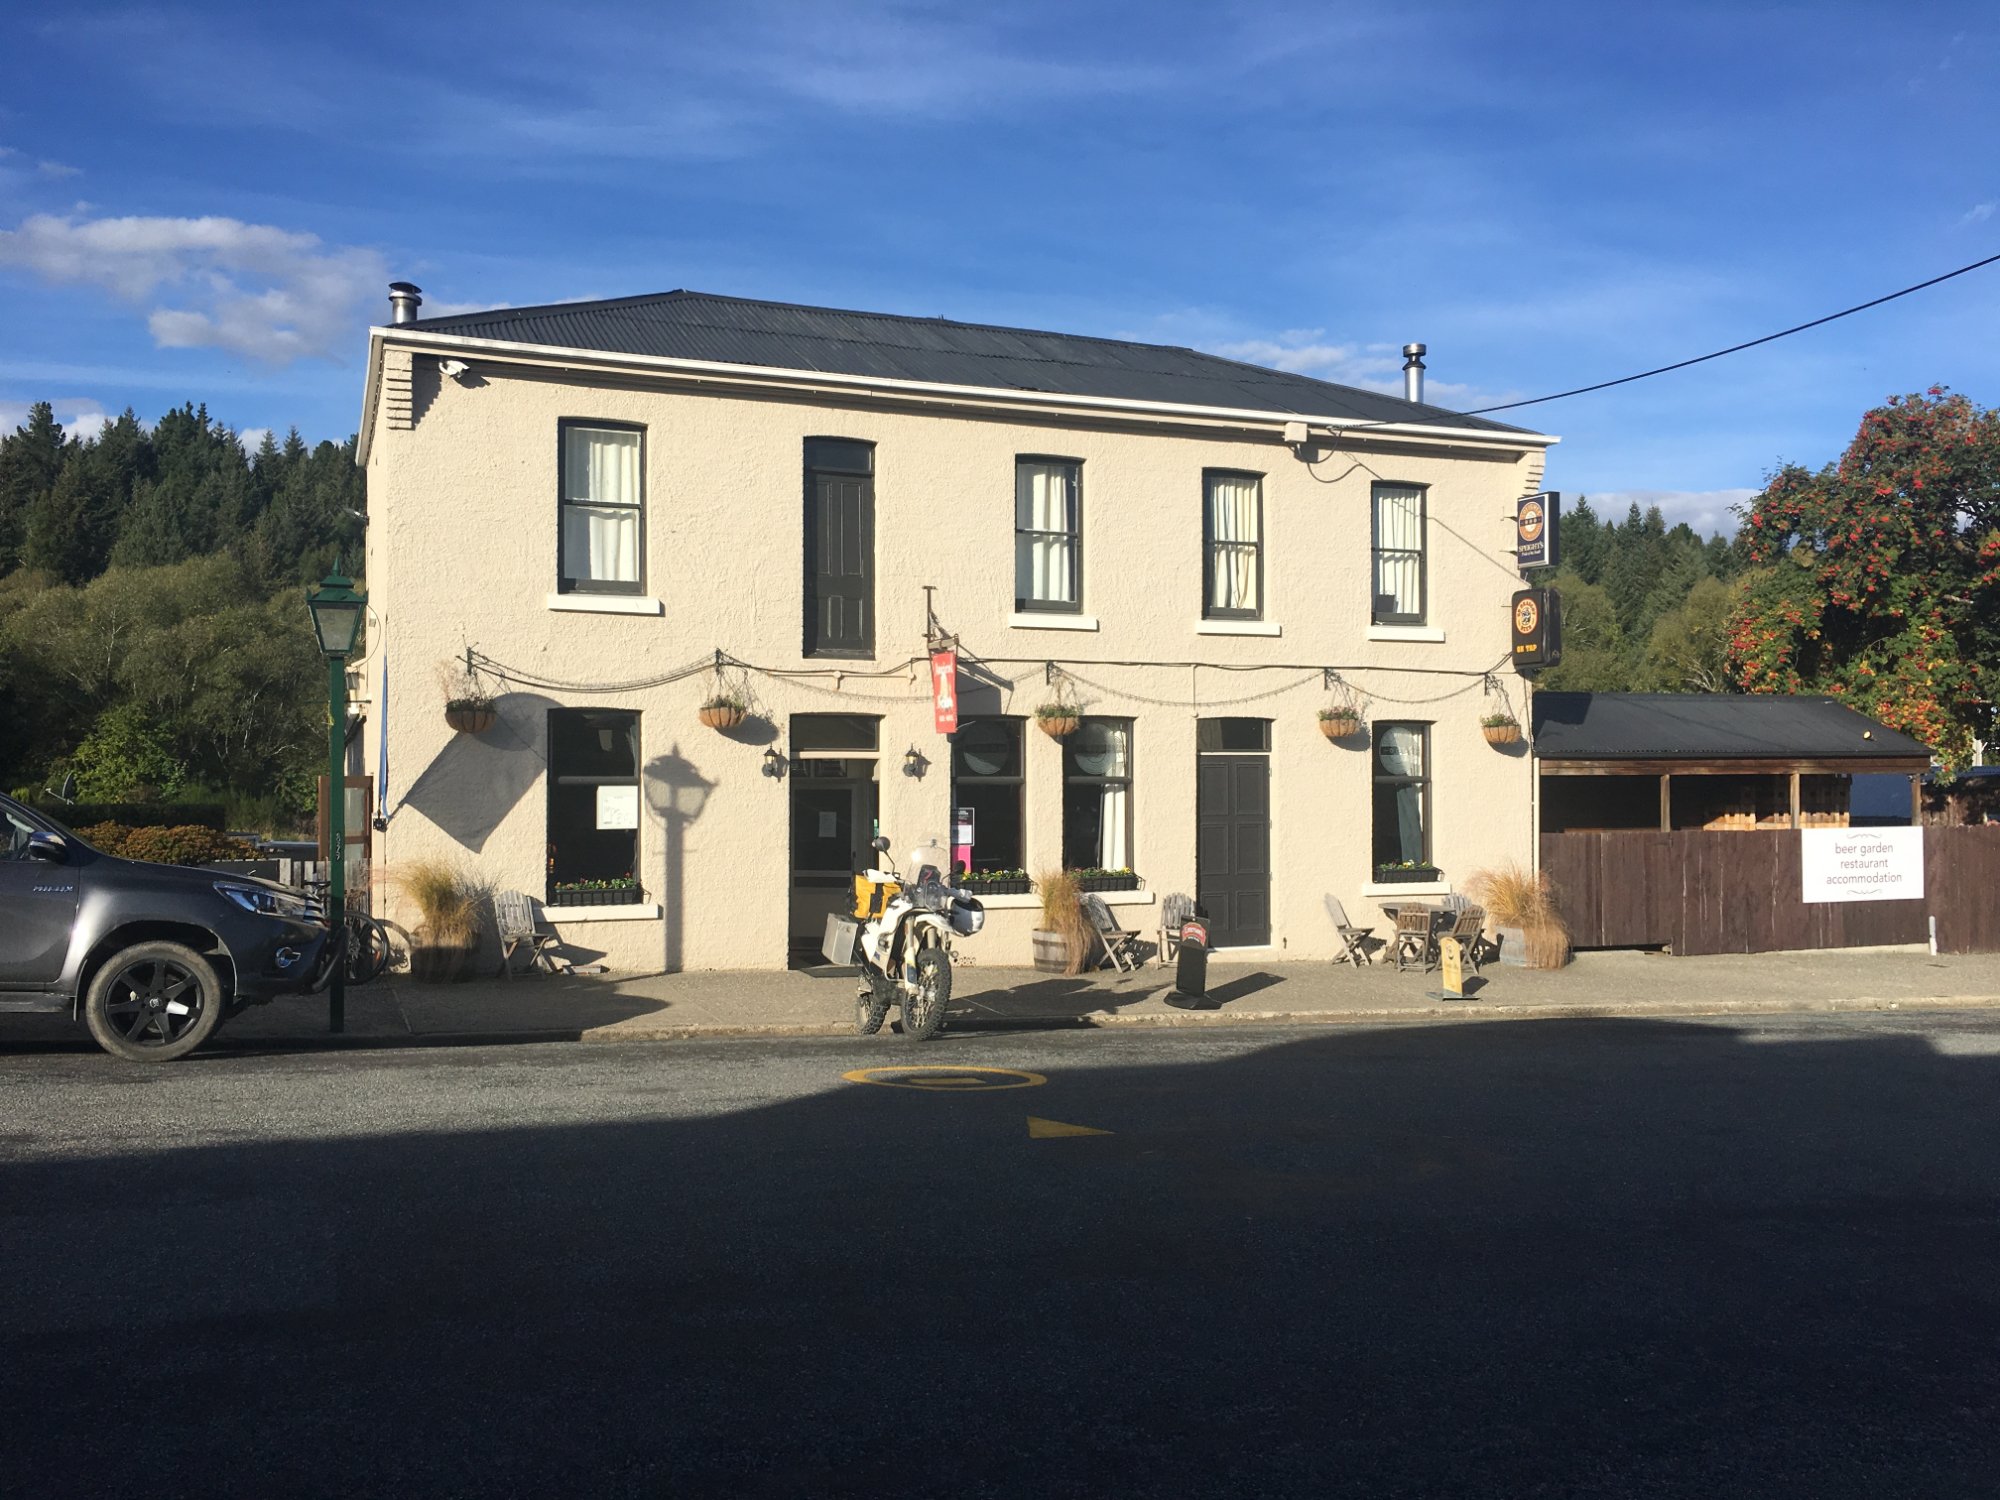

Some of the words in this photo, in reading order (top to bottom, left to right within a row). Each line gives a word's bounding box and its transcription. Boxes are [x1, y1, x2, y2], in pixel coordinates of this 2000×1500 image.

[1835, 843, 1857, 854] beer
[1860, 842, 1894, 857] garden
[1840, 859, 1888, 869] restaurant
[1826, 872, 1902, 885] accommodation
